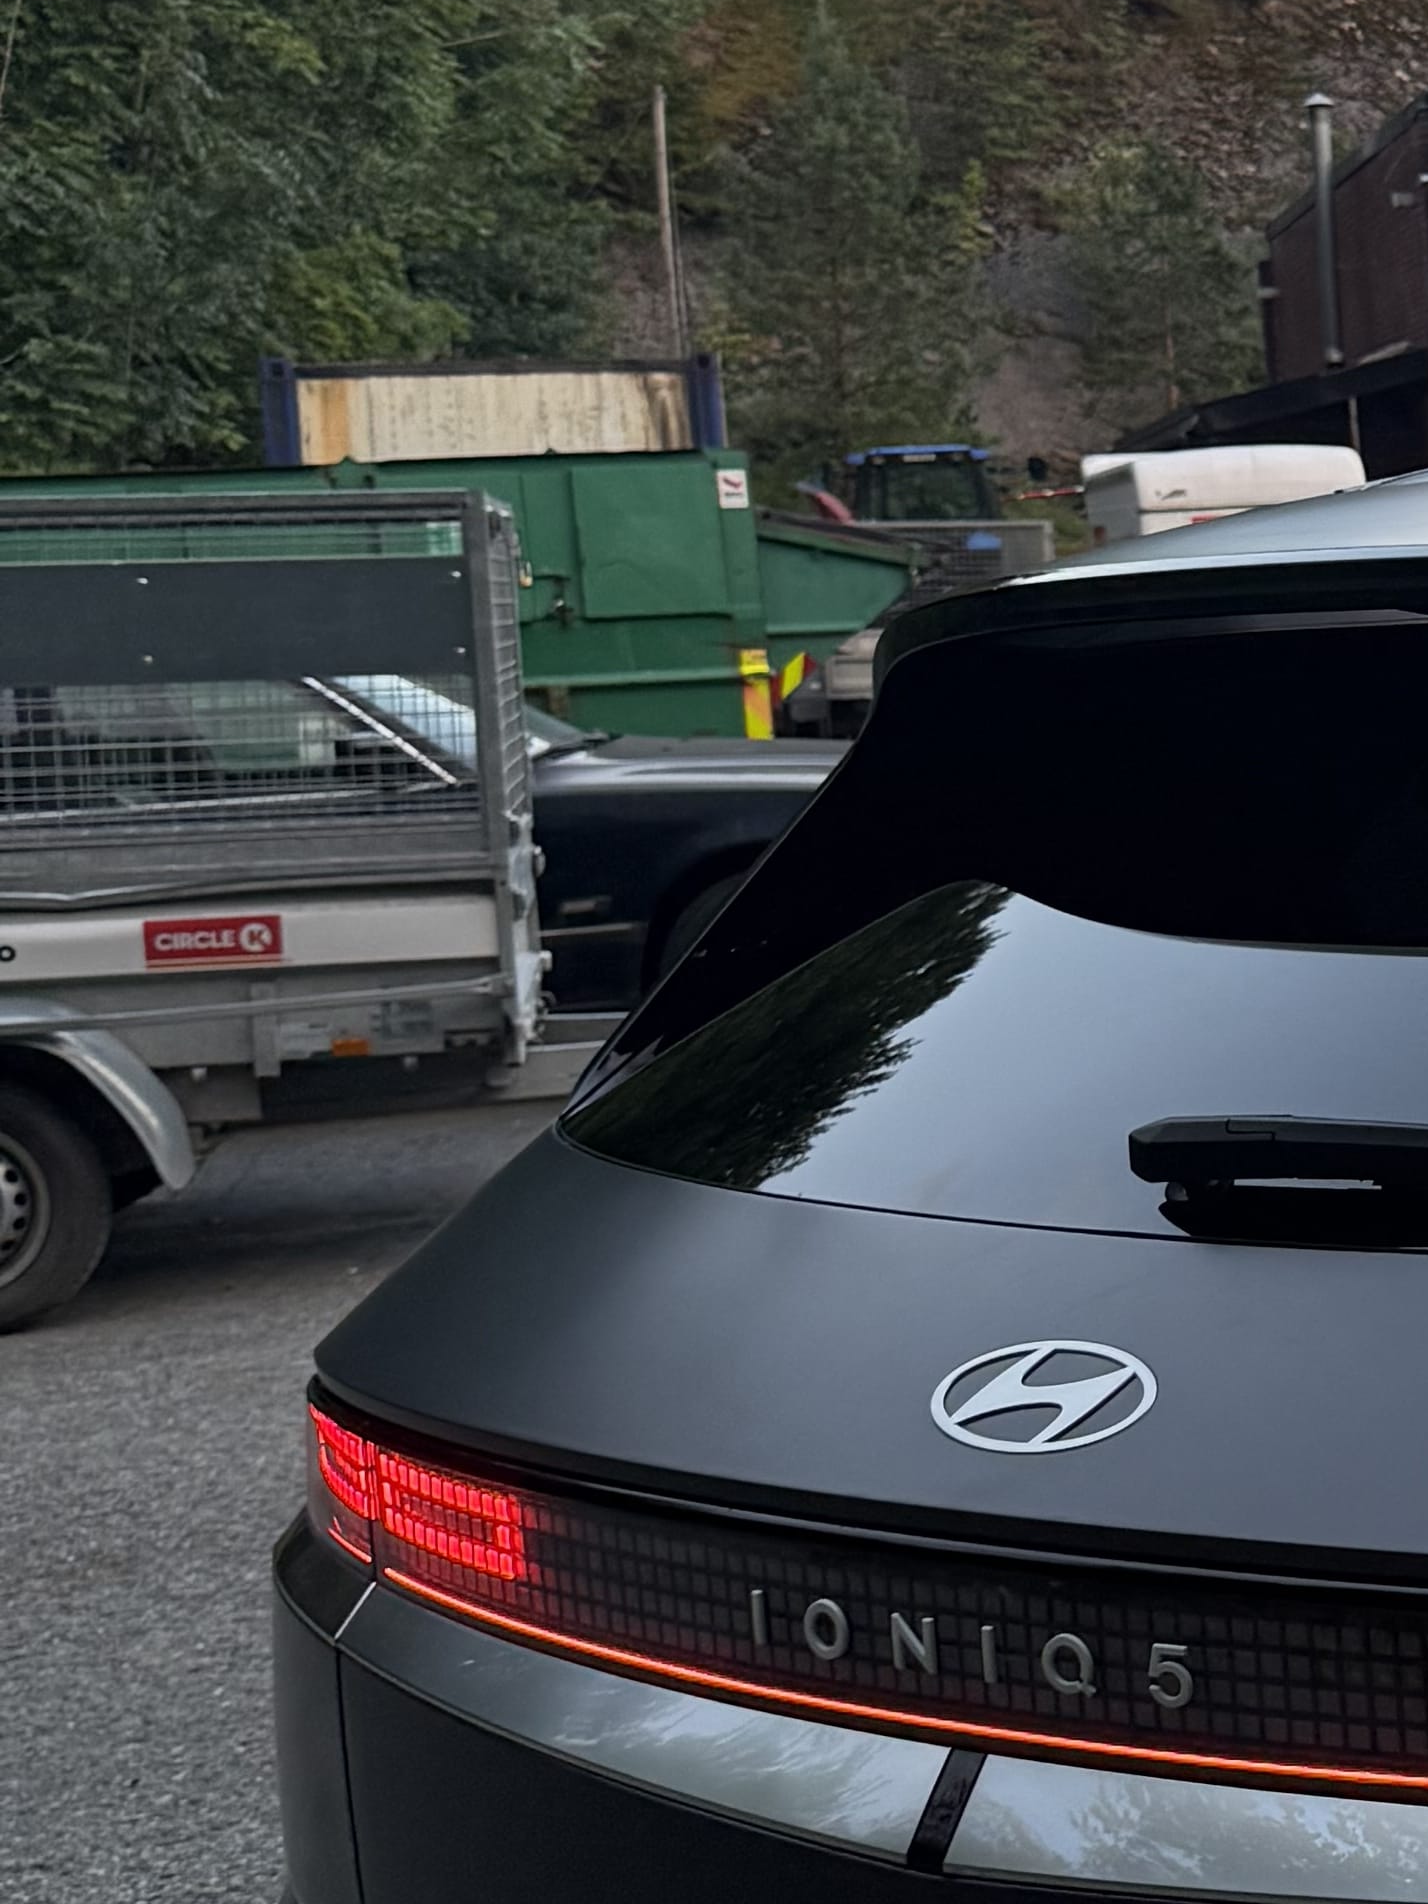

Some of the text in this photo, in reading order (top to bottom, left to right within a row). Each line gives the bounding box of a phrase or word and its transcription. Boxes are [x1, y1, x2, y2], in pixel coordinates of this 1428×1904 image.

[154, 929, 236, 952] CIRCLE
[751, 1589, 1193, 1709] IONIQ 5
